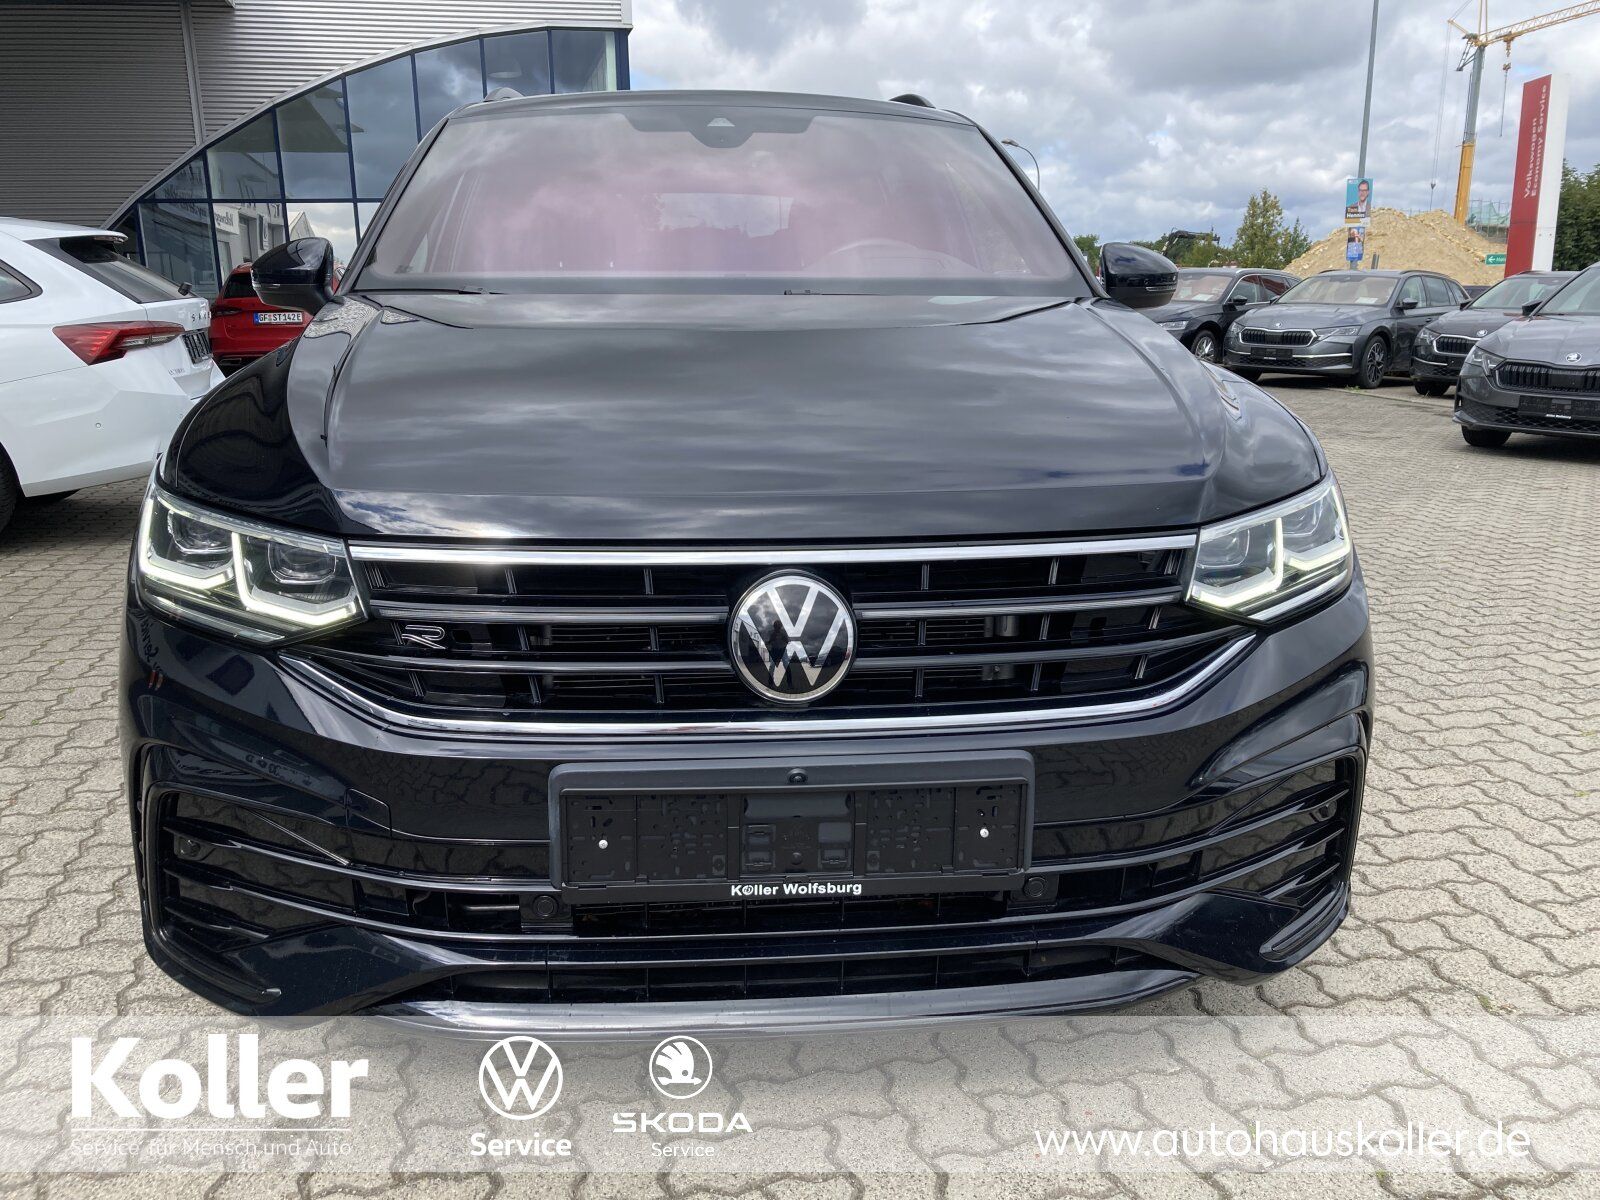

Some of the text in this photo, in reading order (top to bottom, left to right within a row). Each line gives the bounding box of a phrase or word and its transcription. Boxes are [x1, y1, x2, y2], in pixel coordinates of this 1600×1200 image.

[1523, 118, 1537, 198] Volkswagen
[1530, 84, 1547, 197] Economy Service
[782, 882, 862, 895] Wolfsburg
